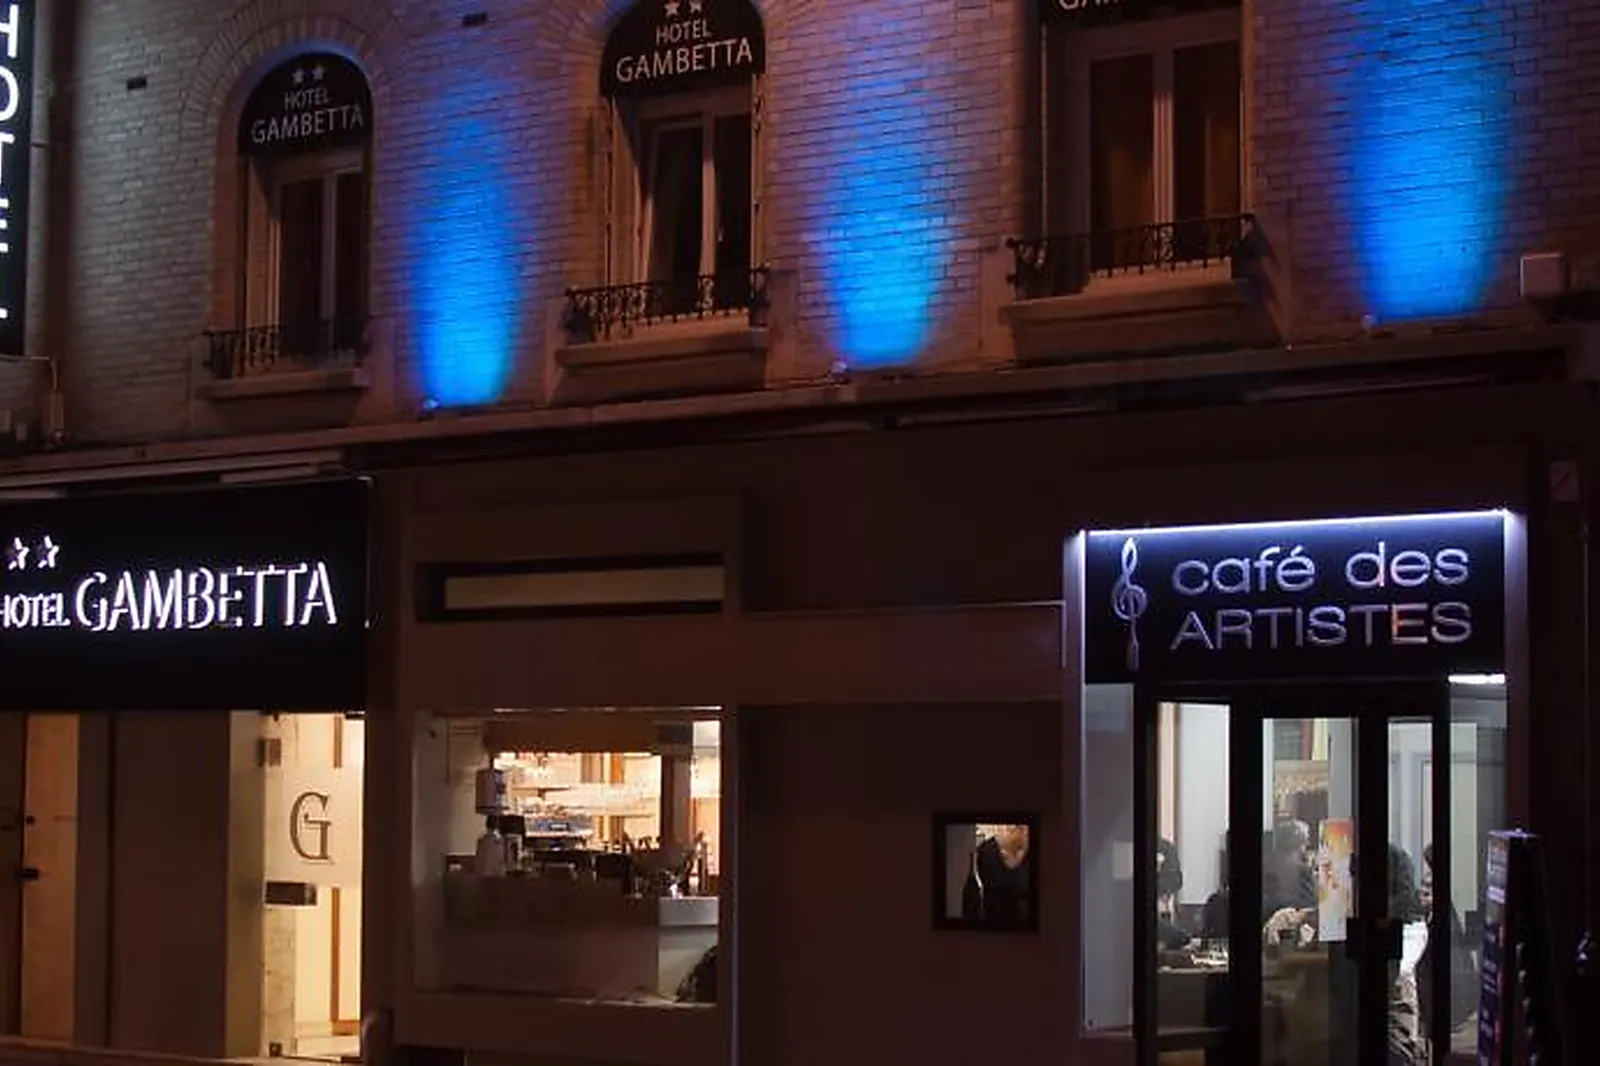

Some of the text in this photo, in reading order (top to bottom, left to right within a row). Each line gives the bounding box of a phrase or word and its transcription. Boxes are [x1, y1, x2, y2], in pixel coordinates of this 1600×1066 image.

[655, 19, 712, 44] HOTEL
[616, 37, 753, 82] GAMBETTA
[284, 87, 330, 111] HOTEL
[251, 103, 364, 143] GAMBETTA
[1172, 541, 1470, 595] café des
[75, 561, 337, 632] GAMBETTA
[1170, 601, 1473, 650] ARTISTES
[290, 792, 332, 860] G
